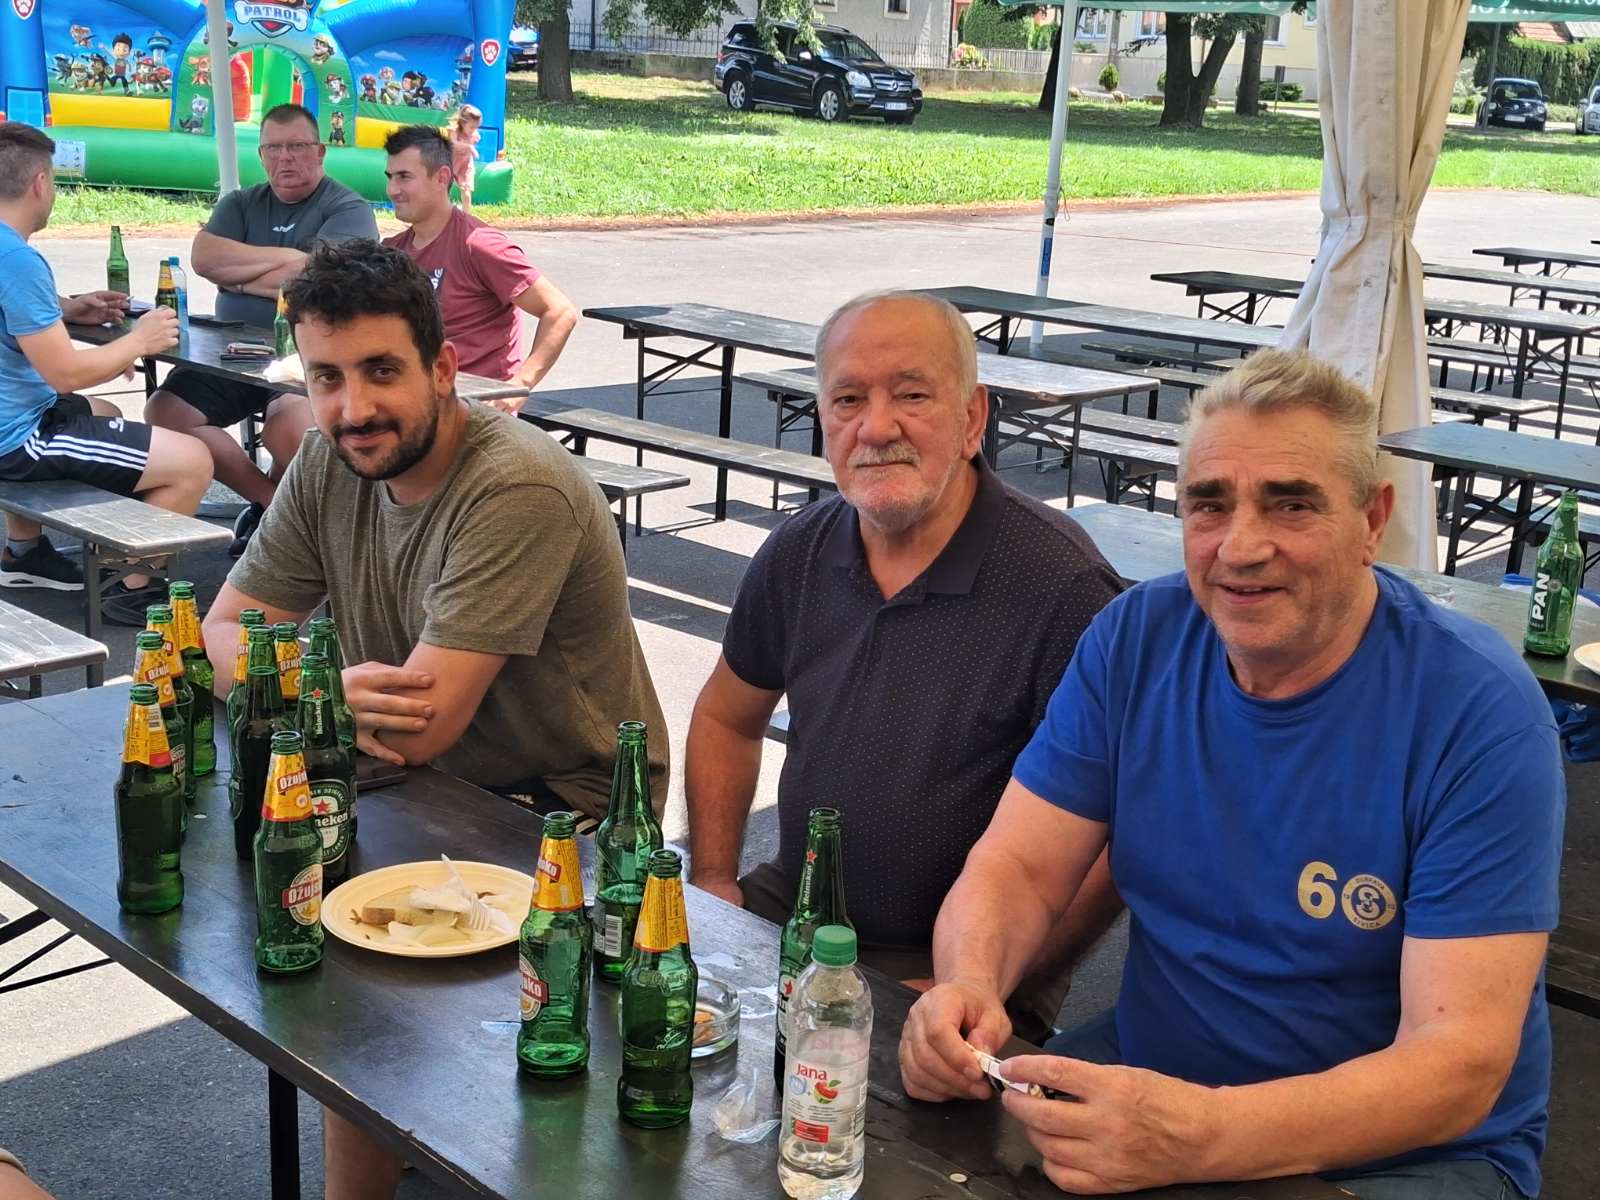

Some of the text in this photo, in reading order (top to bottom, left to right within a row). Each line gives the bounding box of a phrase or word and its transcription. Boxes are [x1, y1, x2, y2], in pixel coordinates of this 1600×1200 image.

[243, 5, 302, 22] PATROL
[1532, 572, 1550, 621] PAN
[802, 864, 813, 905] Heineken
